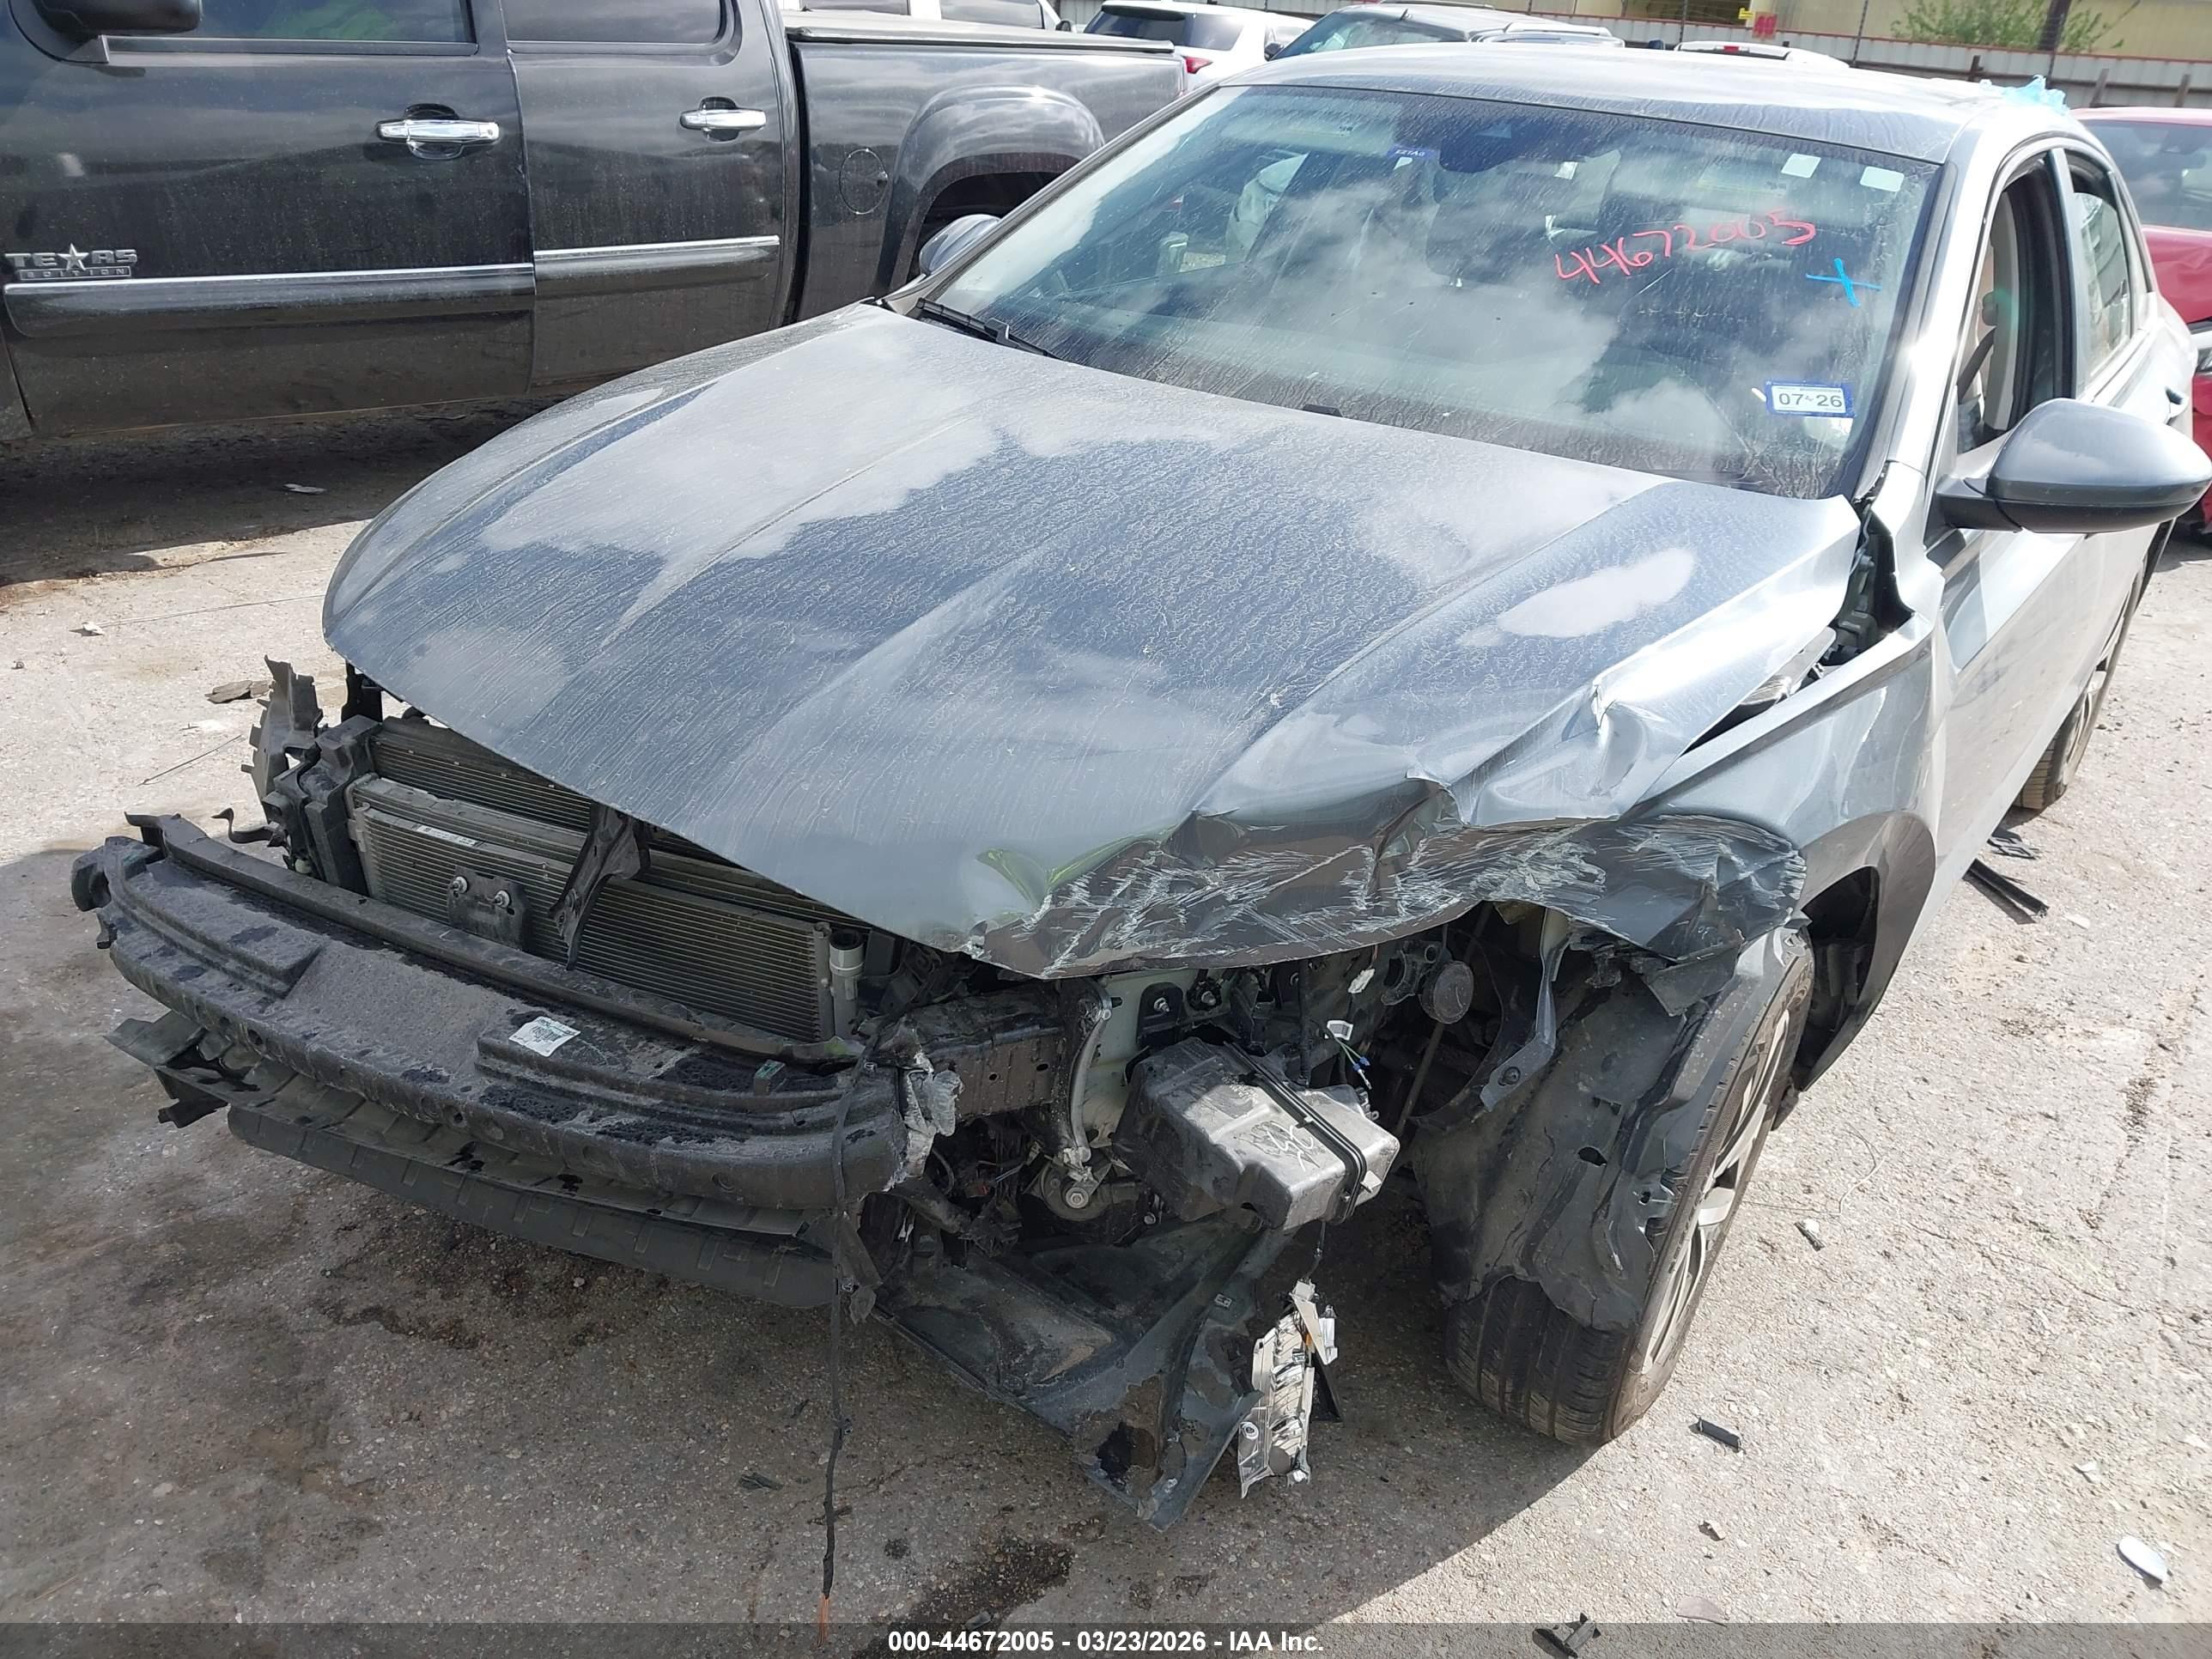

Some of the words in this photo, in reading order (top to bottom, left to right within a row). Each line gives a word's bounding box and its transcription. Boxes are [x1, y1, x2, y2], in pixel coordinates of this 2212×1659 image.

[4, 243, 137, 271] TEXAS
[1555, 208, 1816, 284] 44672005
[26, 267, 125, 279] EDITION
